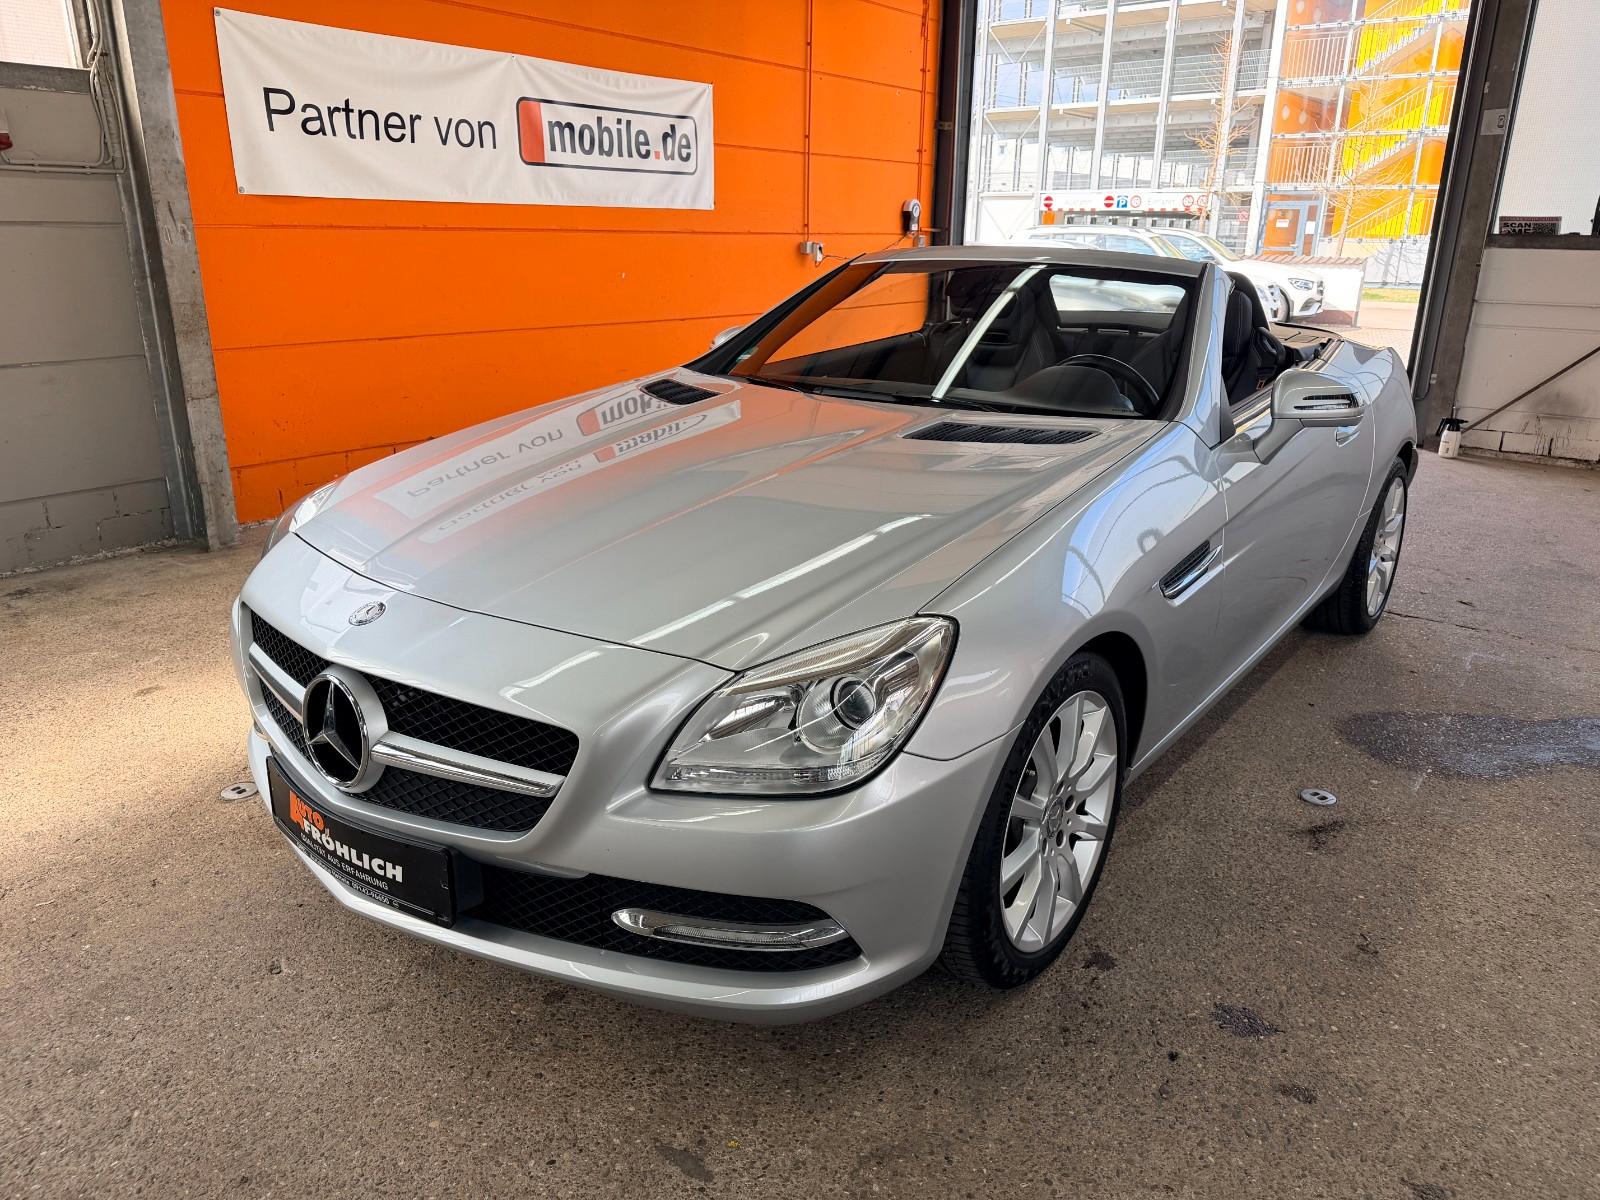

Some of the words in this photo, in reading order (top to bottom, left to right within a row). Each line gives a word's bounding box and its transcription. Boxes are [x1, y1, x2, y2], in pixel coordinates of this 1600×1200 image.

[263, 87, 421, 143] Partner
[434, 116, 497, 149] von
[548, 116, 692, 162] mobile.de
[290, 790, 325, 830] AUTO
[303, 818, 403, 883] FRÖHLICH
[341, 862, 389, 890] ERFAHRUNG
